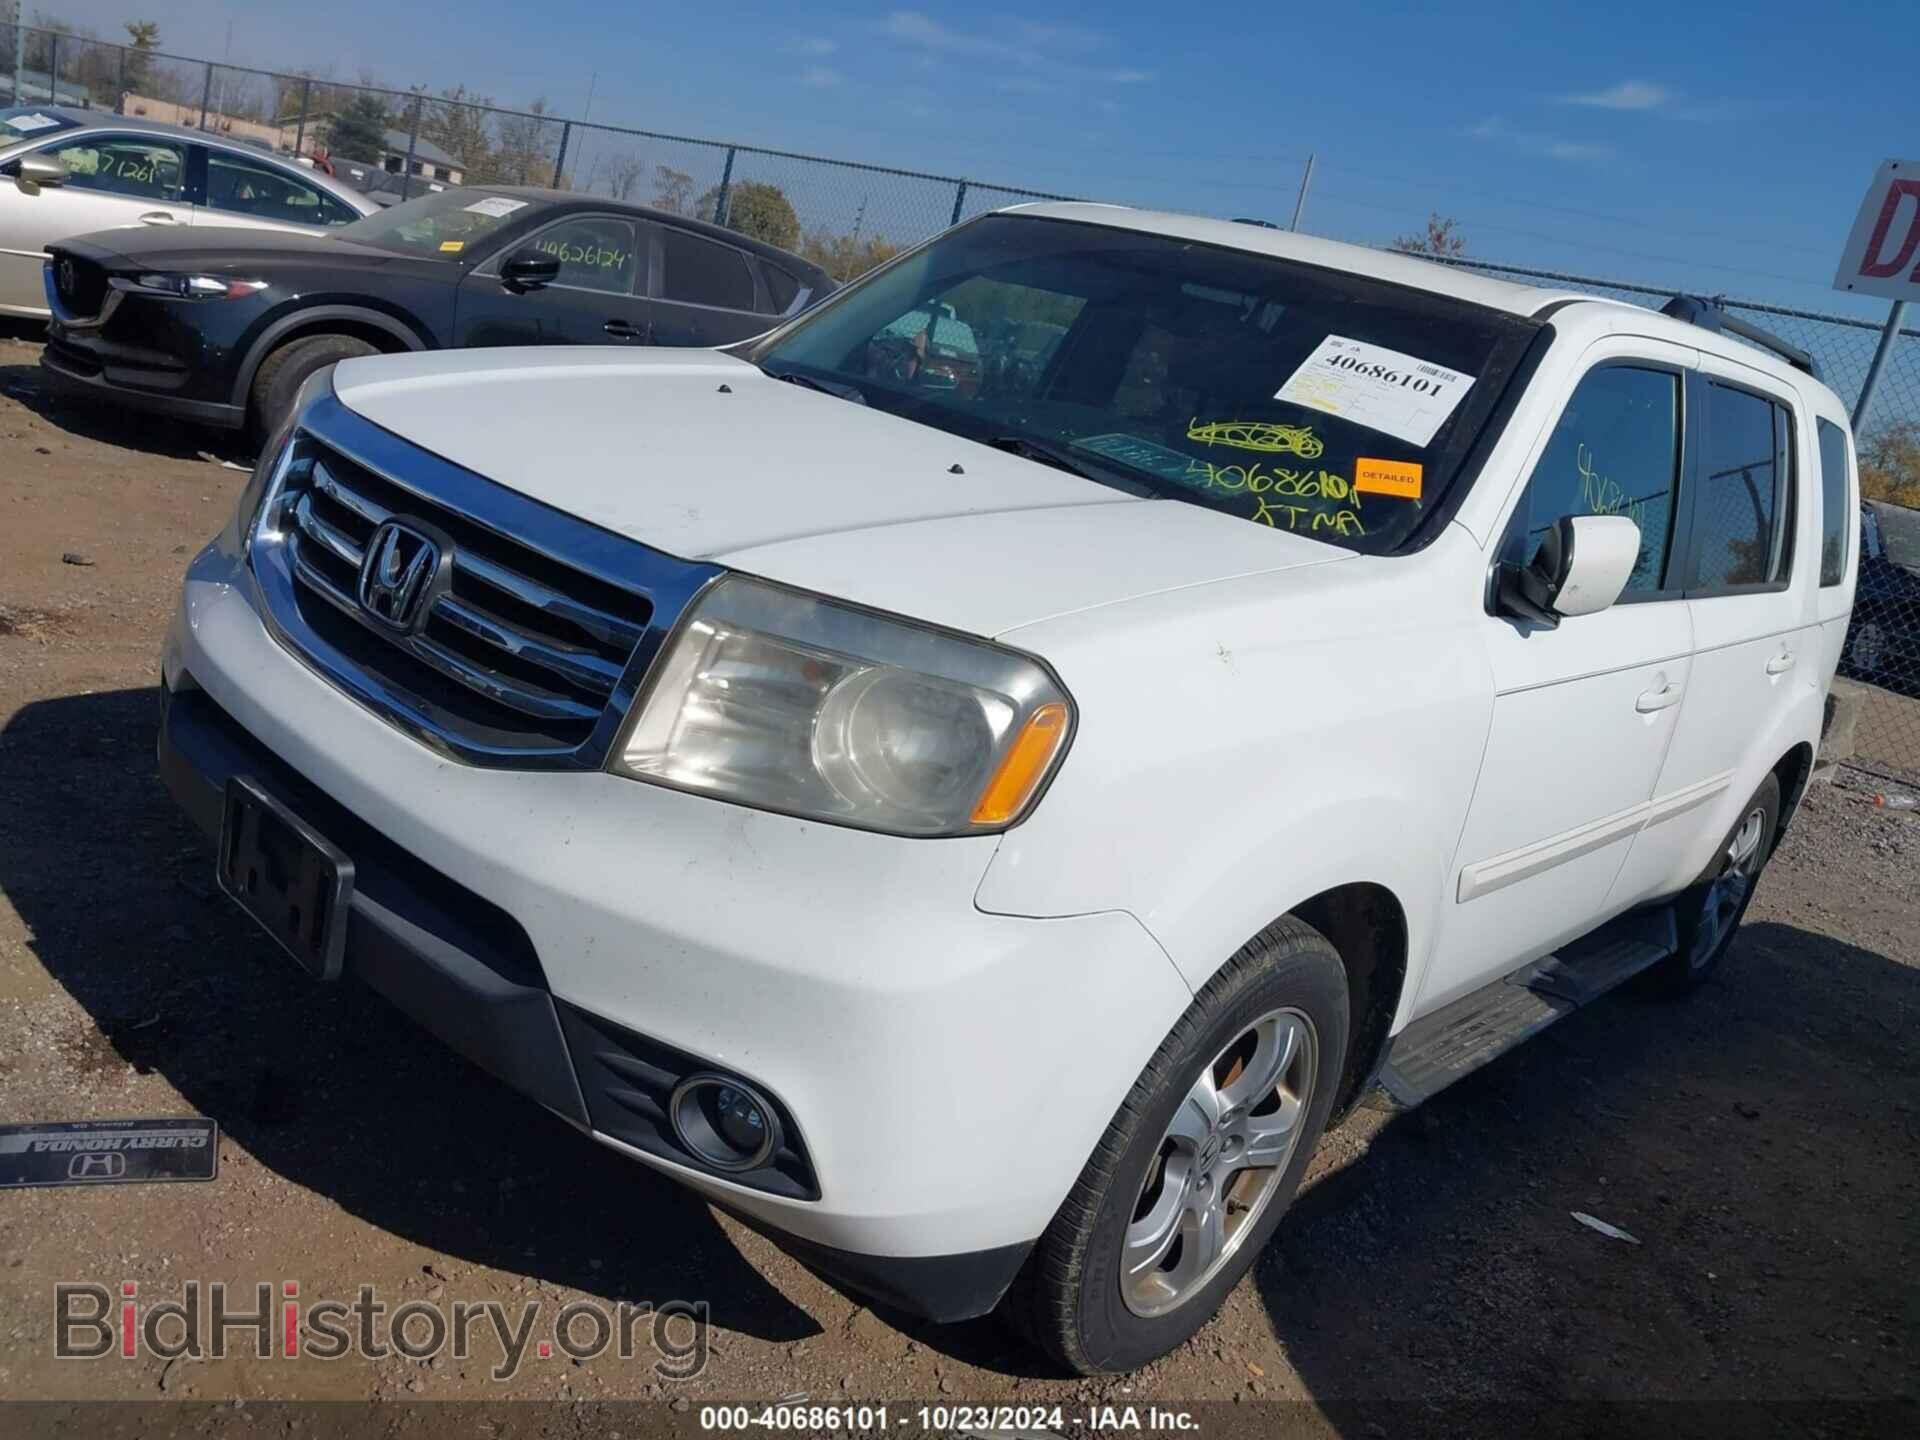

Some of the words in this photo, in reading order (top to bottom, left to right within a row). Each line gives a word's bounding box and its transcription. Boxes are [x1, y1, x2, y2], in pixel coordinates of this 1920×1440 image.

[1857, 178, 1920, 283] D
[1325, 354, 1443, 398] 40686101
[1362, 471, 1416, 484] DETAILED
[34, 1138, 124, 1153] HONDA
[122, 1136, 208, 1150] CURRY
